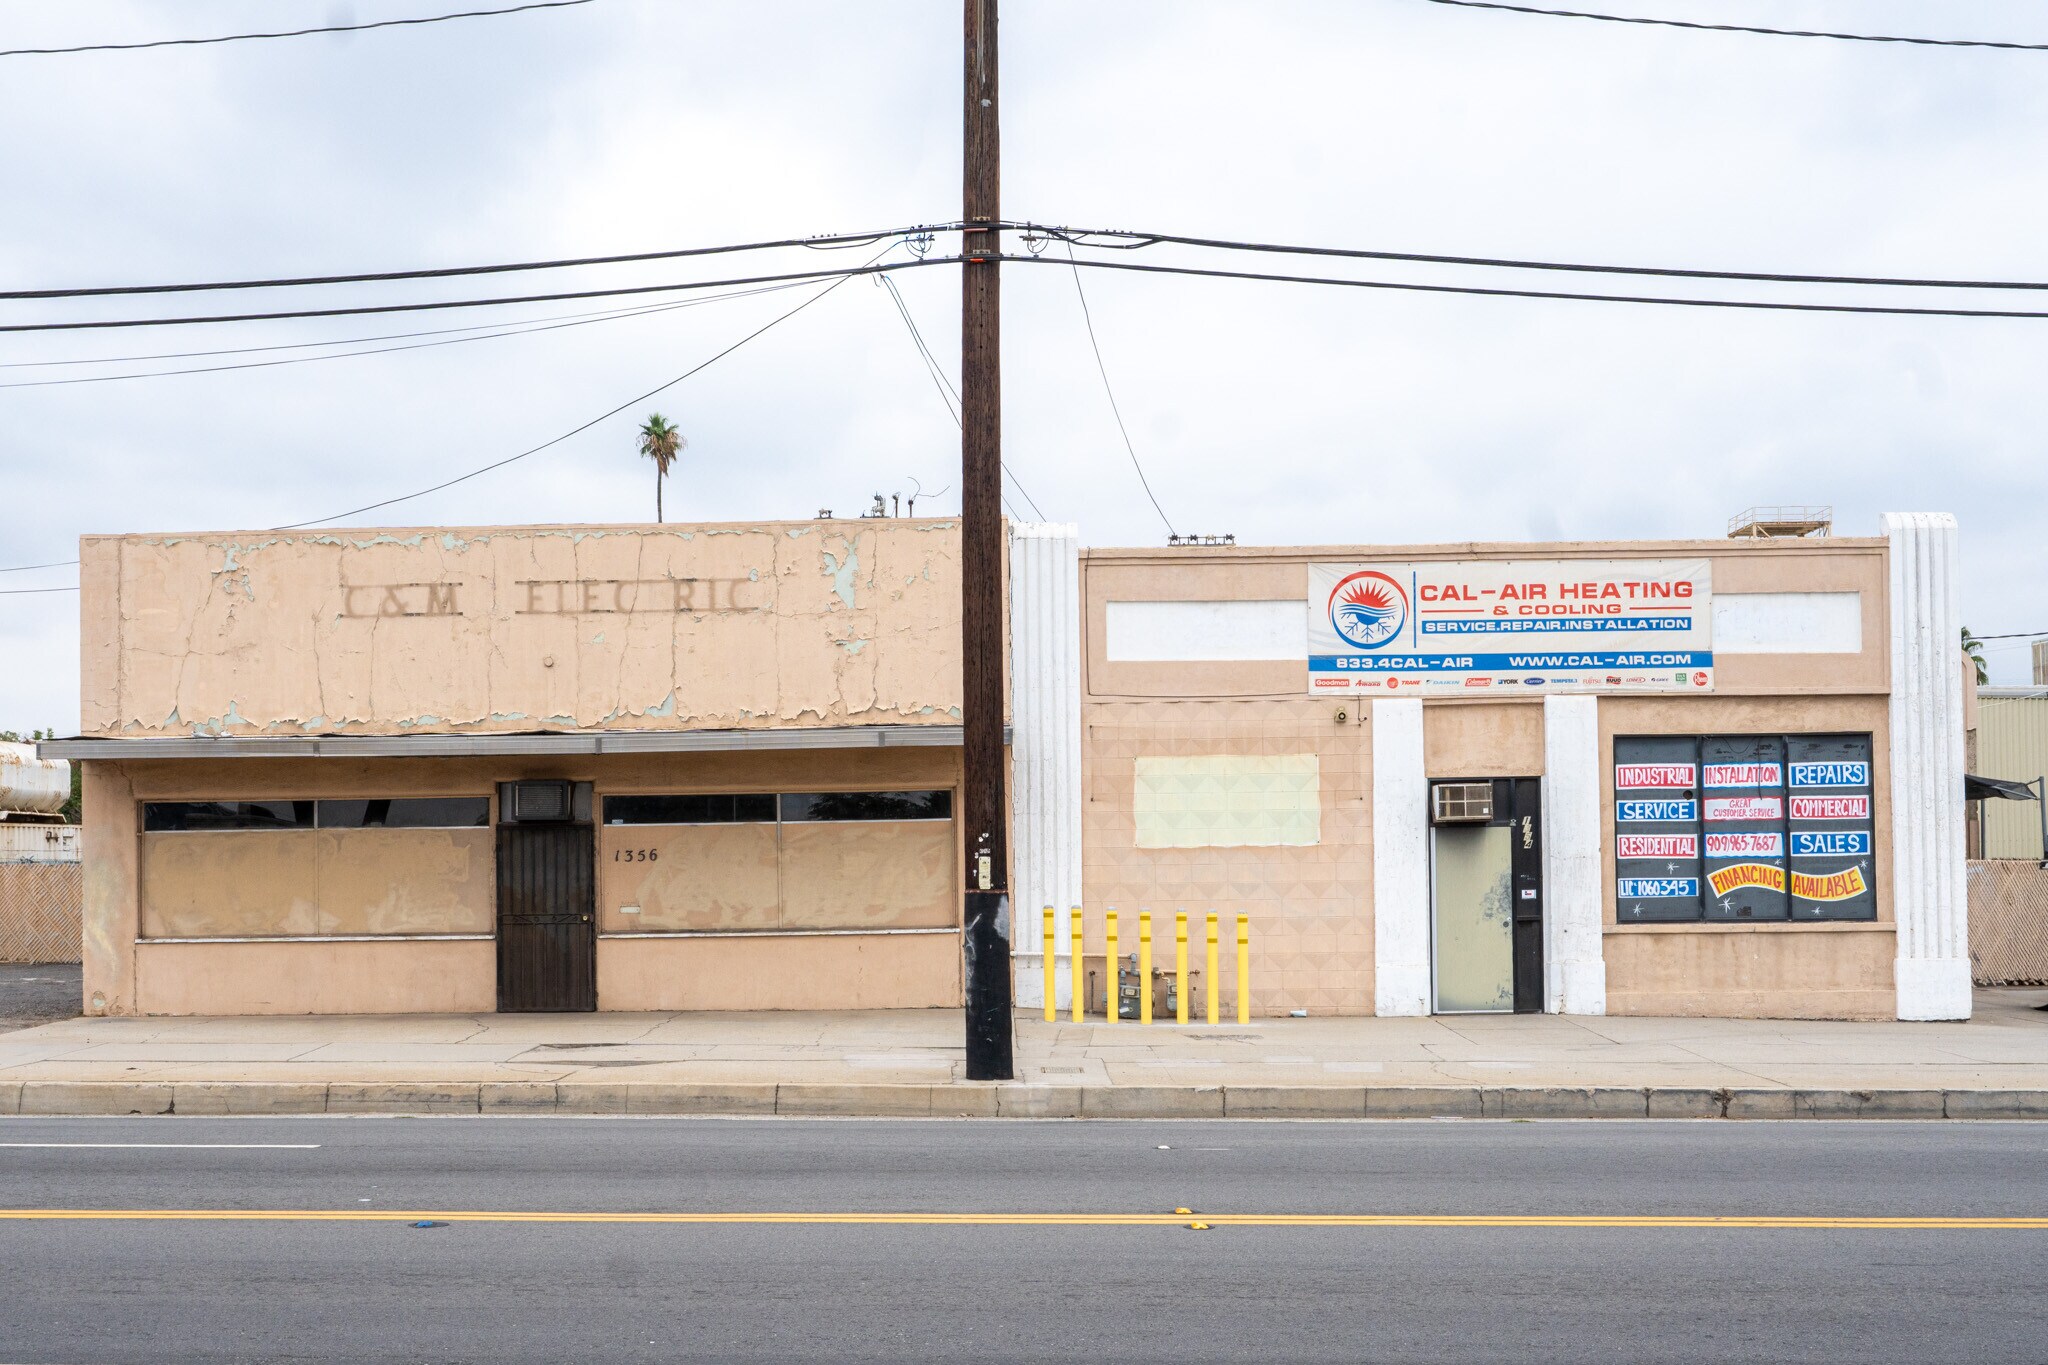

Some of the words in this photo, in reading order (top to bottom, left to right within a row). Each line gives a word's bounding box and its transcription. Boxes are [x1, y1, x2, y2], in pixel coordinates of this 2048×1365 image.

[1420, 582, 1547, 601] CAL-AIR
[1560, 581, 1693, 599] HEATING
[1493, 604, 1509, 616] &
[1518, 603, 1622, 615] COOLING
[1336, 656, 1474, 669] 833.4CAL-AIR
[1509, 653, 1692, 667] WWW.CAL-AIR.COM
[1620, 768, 1693, 785] INDUSTRIAL
[1705, 766, 1779, 784] INSTALLATION
[1795, 765, 1863, 785] REPAIRS
[1623, 802, 1689, 819] SERVICE
[1713, 808, 1748, 818] CUSTOMER
[1749, 808, 1775, 817] SERVICE
[1729, 799, 1752, 809] GREAT
[1792, 798, 1866, 817] COMMERCIAL
[1620, 837, 1695, 856] RESIDENTIAL
[1800, 834, 1860, 853] SALES
[615, 848, 658, 862] 1356
[1710, 865, 1782, 892] FINANCING
[1792, 869, 1861, 898] AVAILABLE
